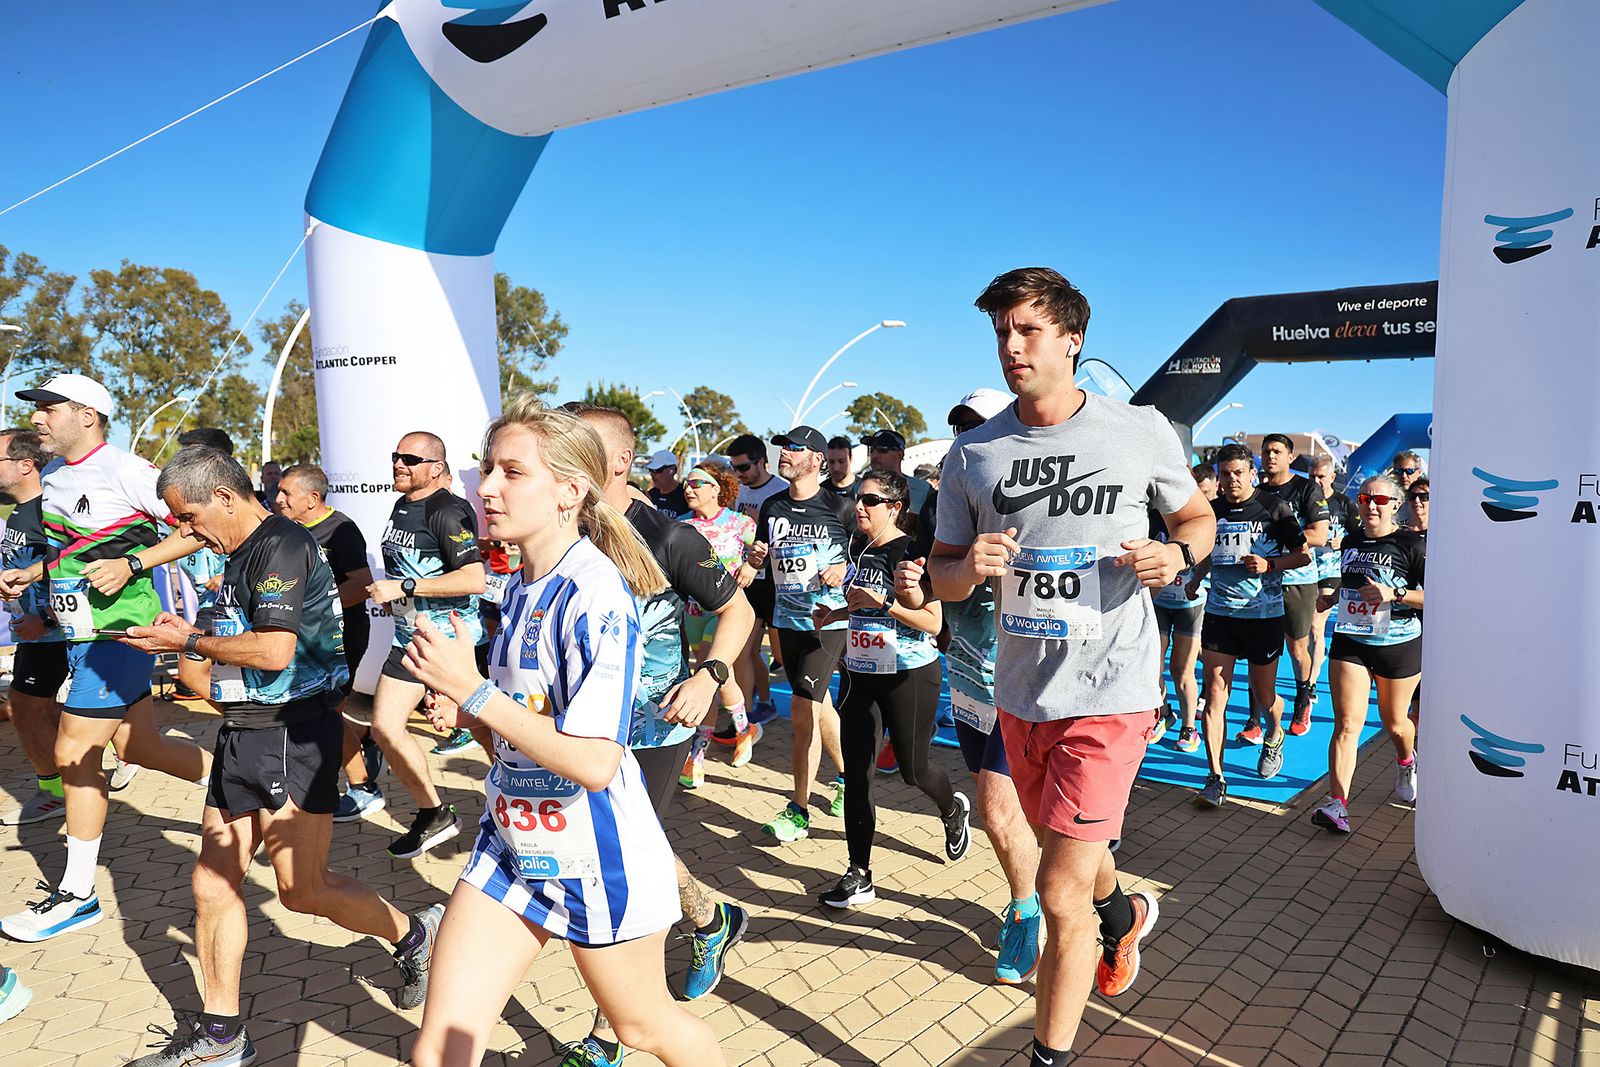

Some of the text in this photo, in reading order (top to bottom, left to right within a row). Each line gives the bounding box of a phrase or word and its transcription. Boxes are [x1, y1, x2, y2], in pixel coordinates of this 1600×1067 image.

[1337, 297, 1428, 312] Vive el deporte
[1272, 324, 1330, 341] Huelva
[1335, 320, 1377, 338] eleva
[1382, 321, 1411, 335] tus
[350, 356, 397, 366] COPPER
[1004, 455, 1075, 488] JUST
[786, 524, 829, 539] HUELVA
[777, 558, 807, 574] 429
[1037, 555, 1070, 563] AVATEL
[1354, 552, 1392, 566] HUELVA
[1013, 569, 1082, 600] 780
[1347, 601, 1380, 616] 647
[1015, 616, 1060, 631] Wayalia
[851, 630, 886, 649] 564
[510, 774, 576, 791] AVATEL '24
[495, 793, 567, 832] 836
